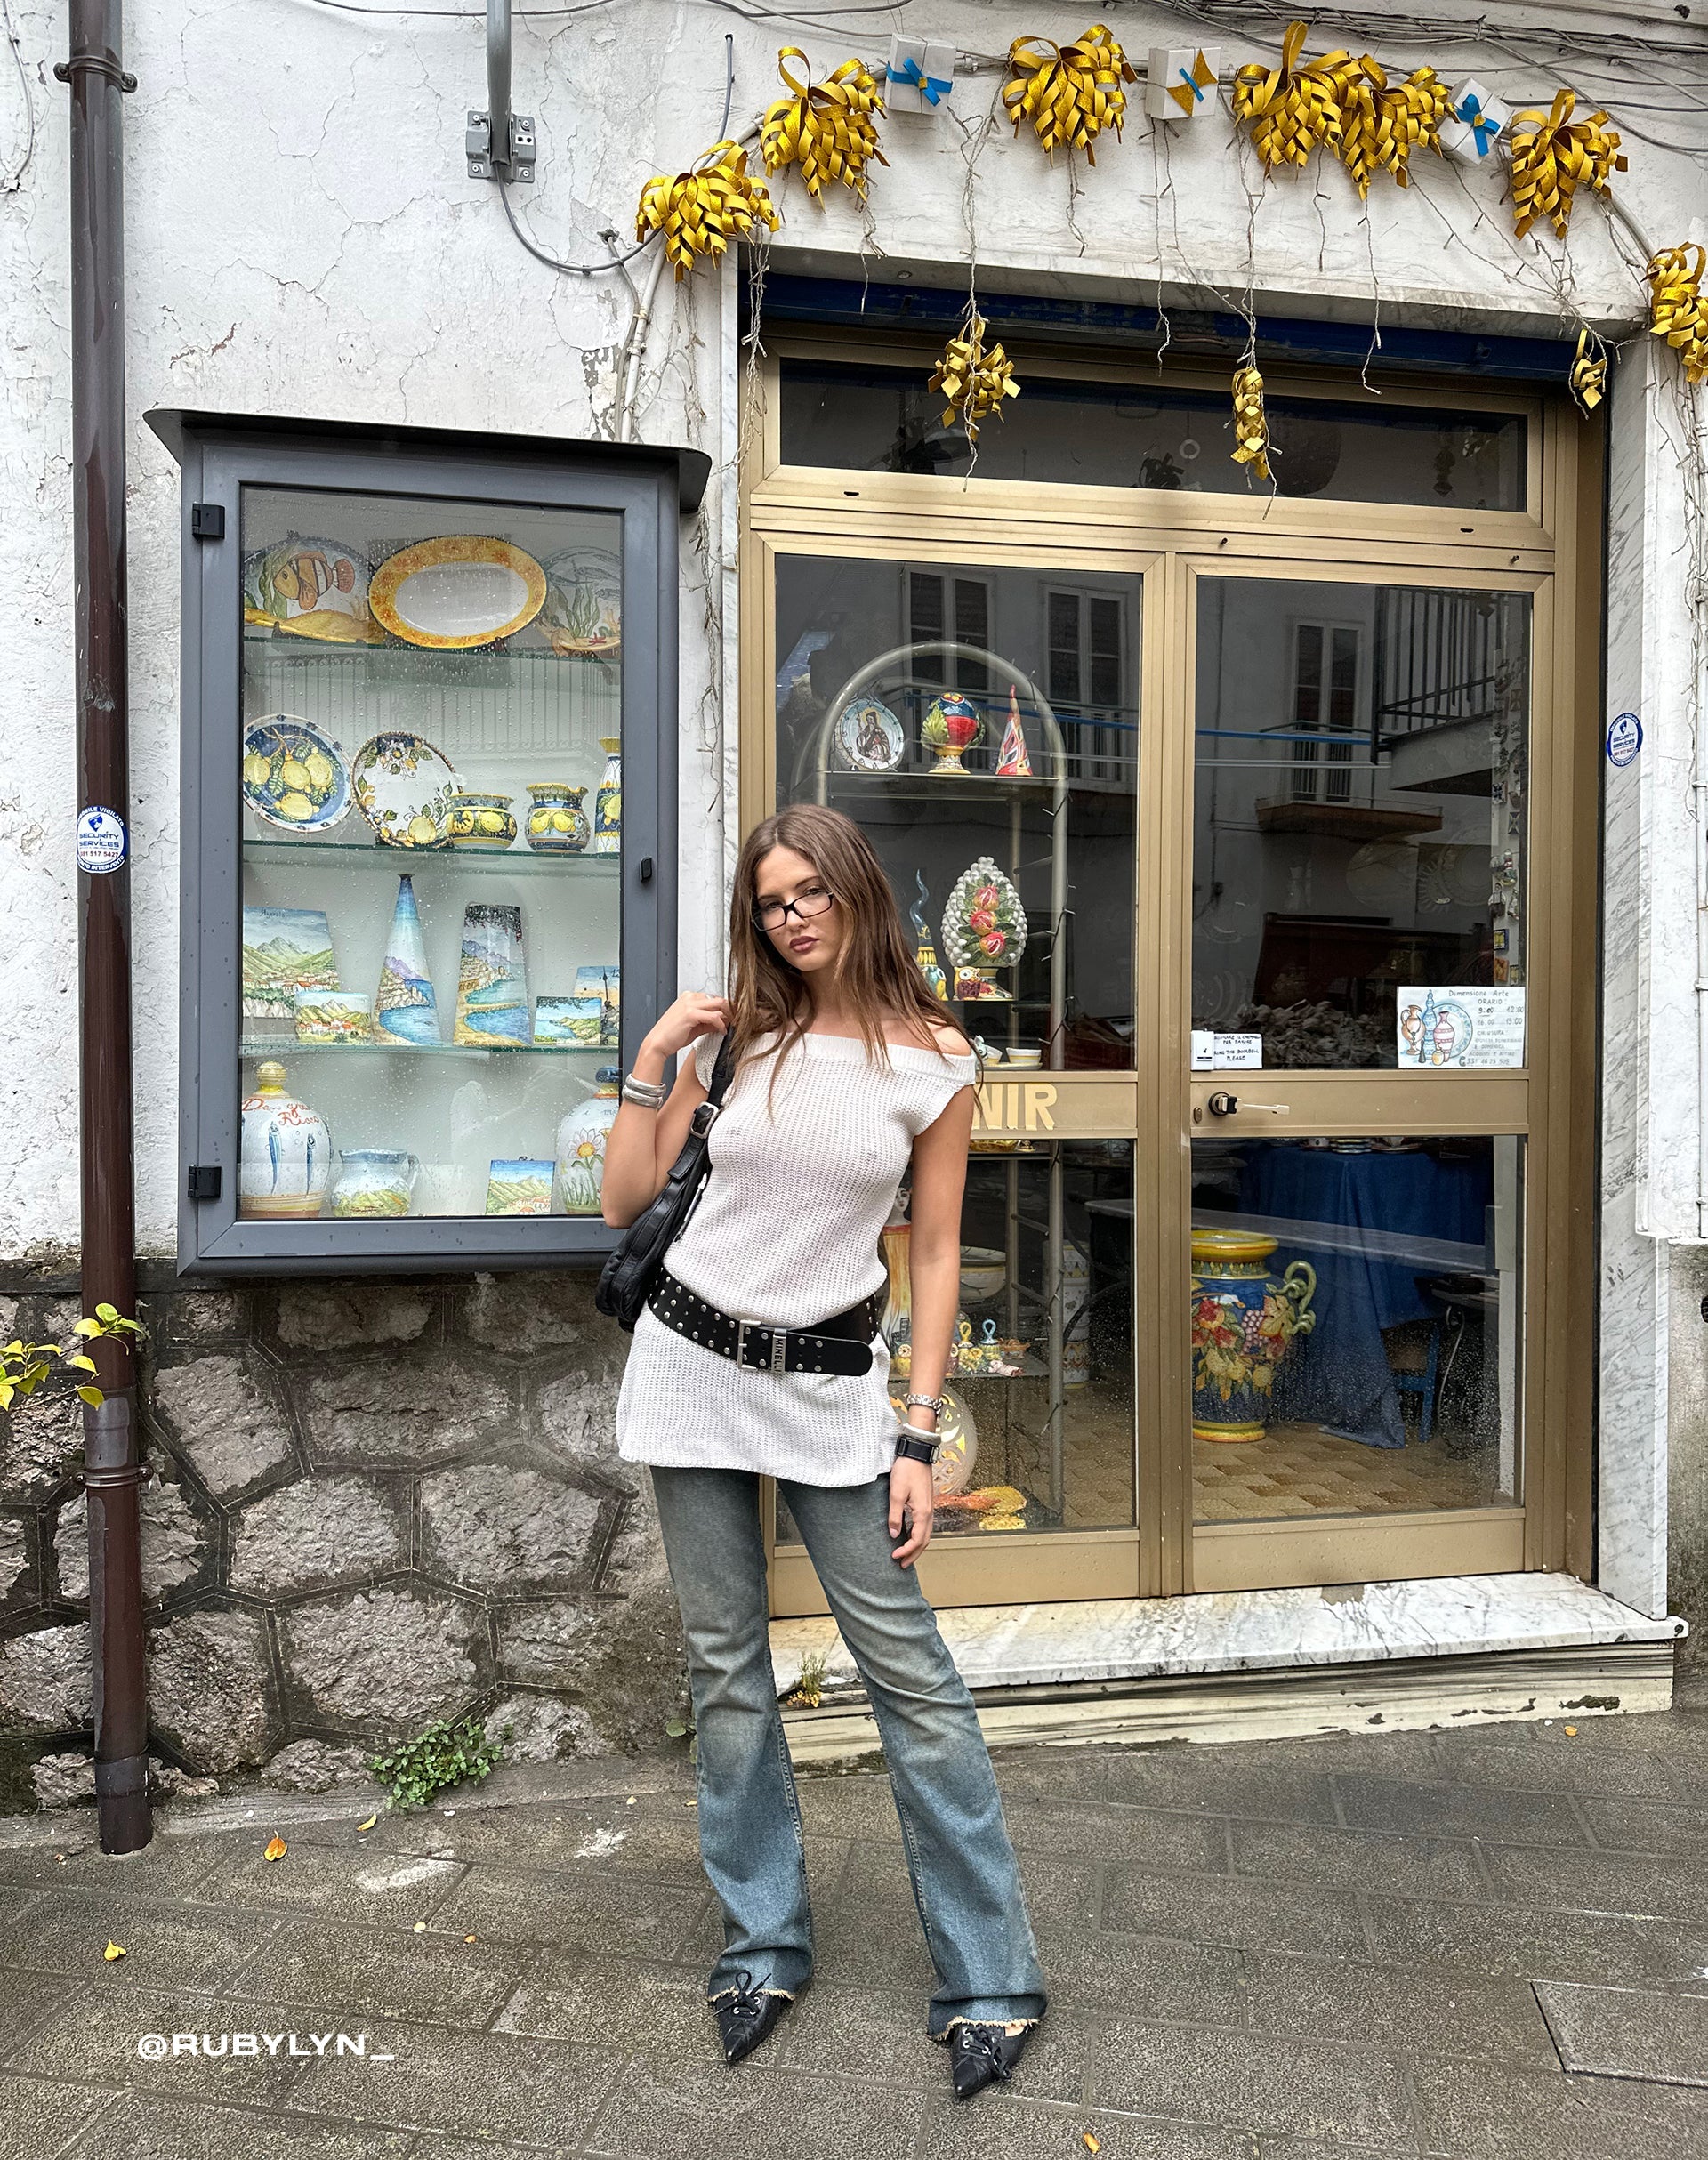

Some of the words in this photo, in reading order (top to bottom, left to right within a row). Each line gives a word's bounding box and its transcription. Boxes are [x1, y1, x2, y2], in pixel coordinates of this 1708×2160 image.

[100, 807, 125, 826] VIGILATO
[79, 831, 119, 840] SECURITY
[79, 838, 120, 848] SERVICES
[1448, 989, 1487, 997] Dimensione
[1492, 989, 1510, 997] Arte
